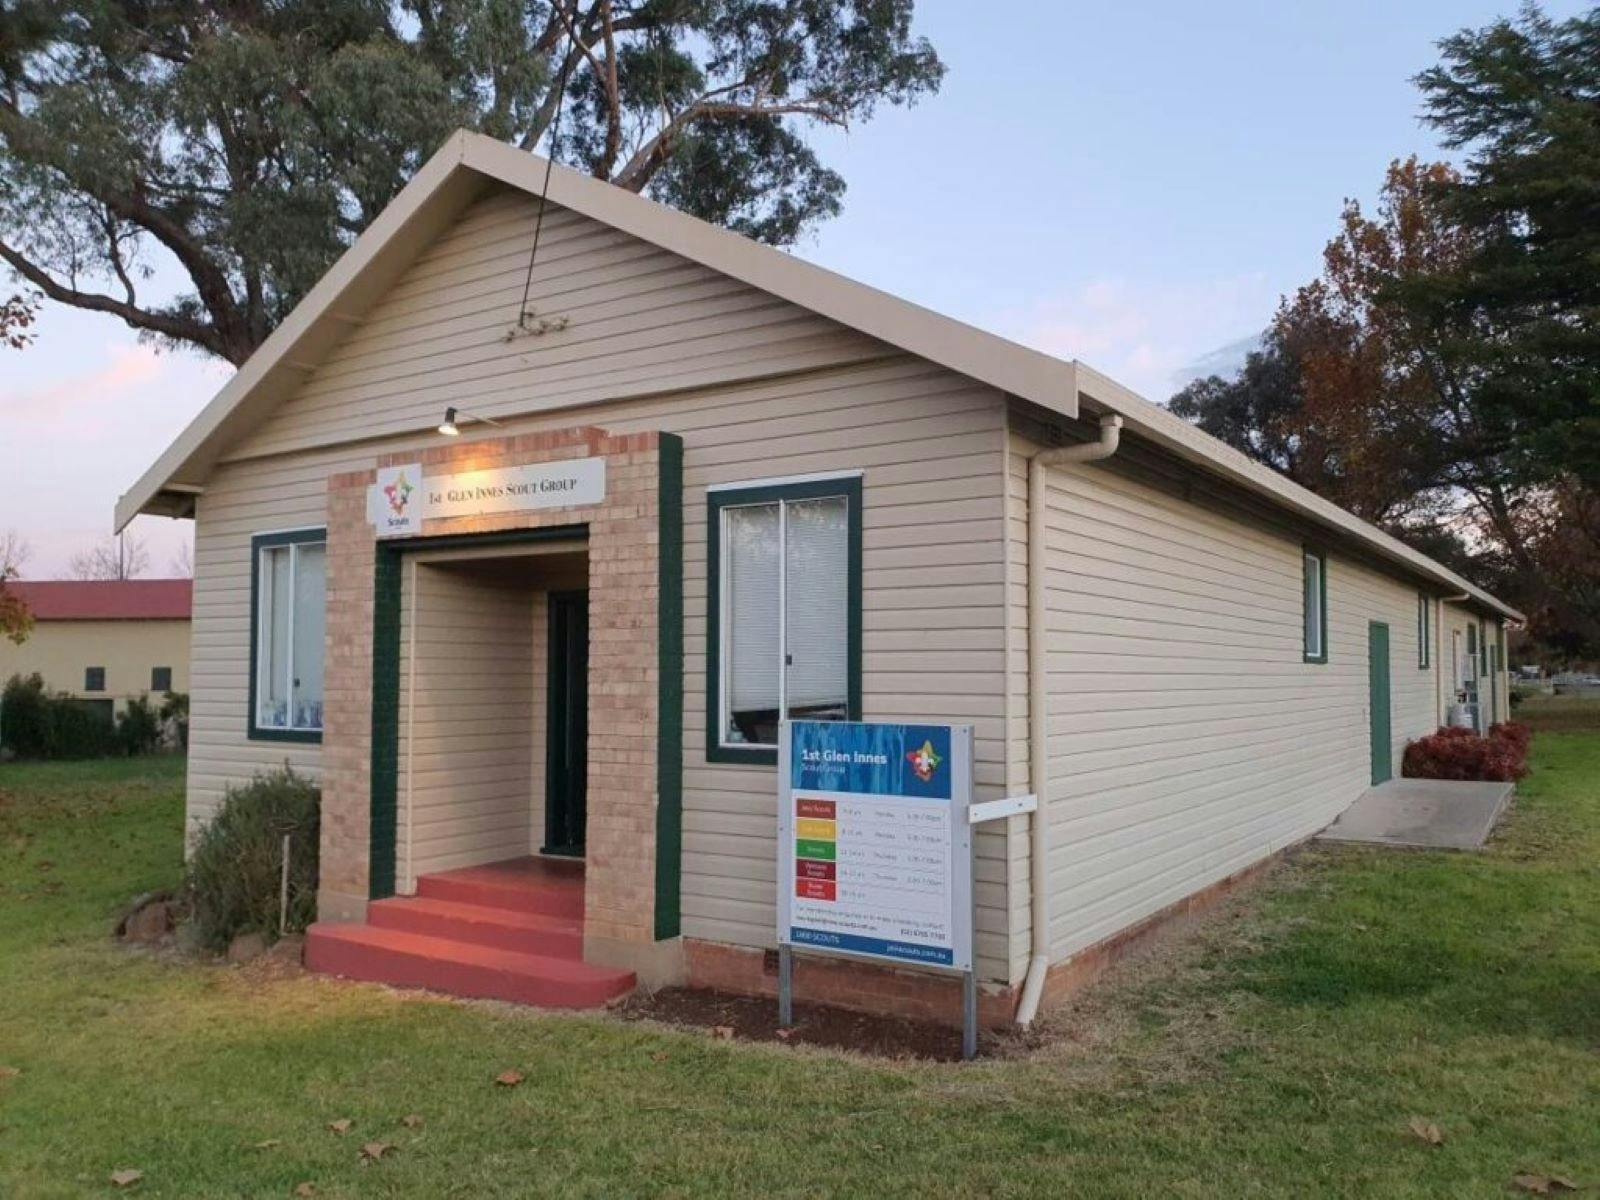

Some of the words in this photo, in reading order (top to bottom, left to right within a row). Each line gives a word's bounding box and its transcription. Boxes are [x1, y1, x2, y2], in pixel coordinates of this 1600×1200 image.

[447, 488, 472, 502] GLEN
[475, 486, 504, 500] INNES
[505, 482, 537, 497] SCOUT
[539, 478, 578, 494] GROUP
[801, 749, 820, 760] 1st
[823, 749, 850, 763] Glen
[853, 750, 888, 765] Innes
